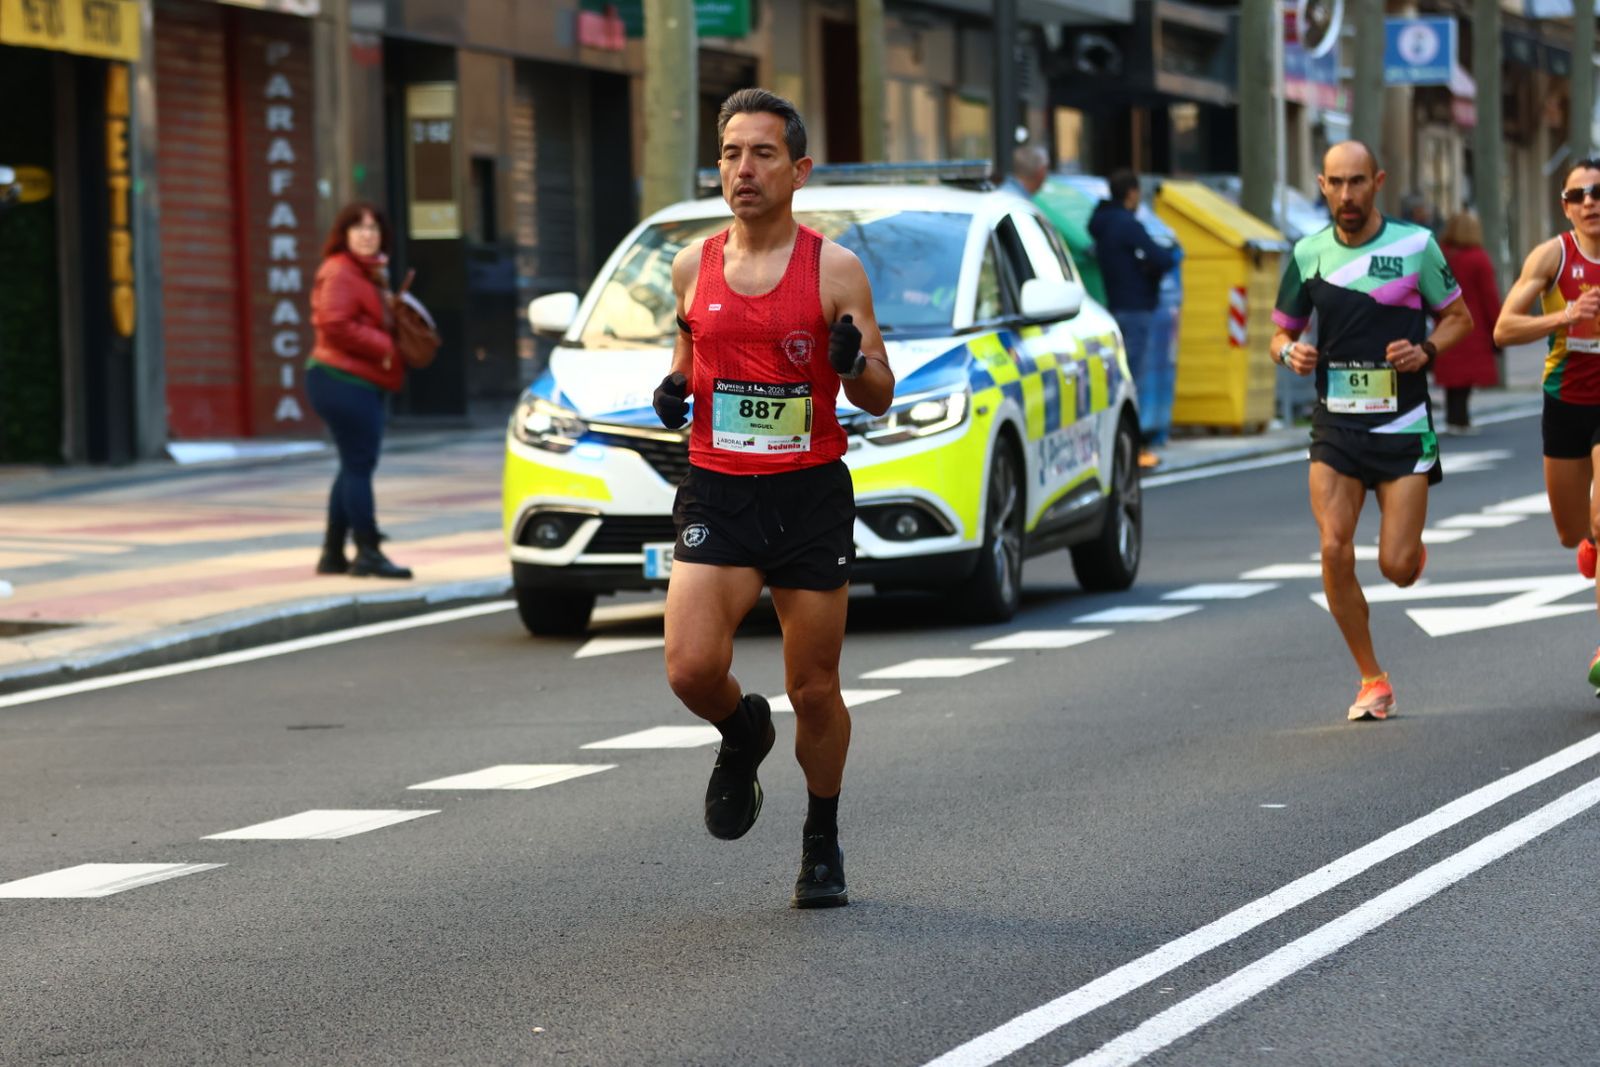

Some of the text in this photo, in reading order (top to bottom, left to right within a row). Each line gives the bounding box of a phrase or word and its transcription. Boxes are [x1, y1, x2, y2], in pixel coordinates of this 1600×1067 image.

[265, 41, 303, 422] PARAFARMACIA
[1350, 373, 1369, 387] 61
[739, 399, 786, 420] 887
[717, 437, 742, 445] LABORAL
